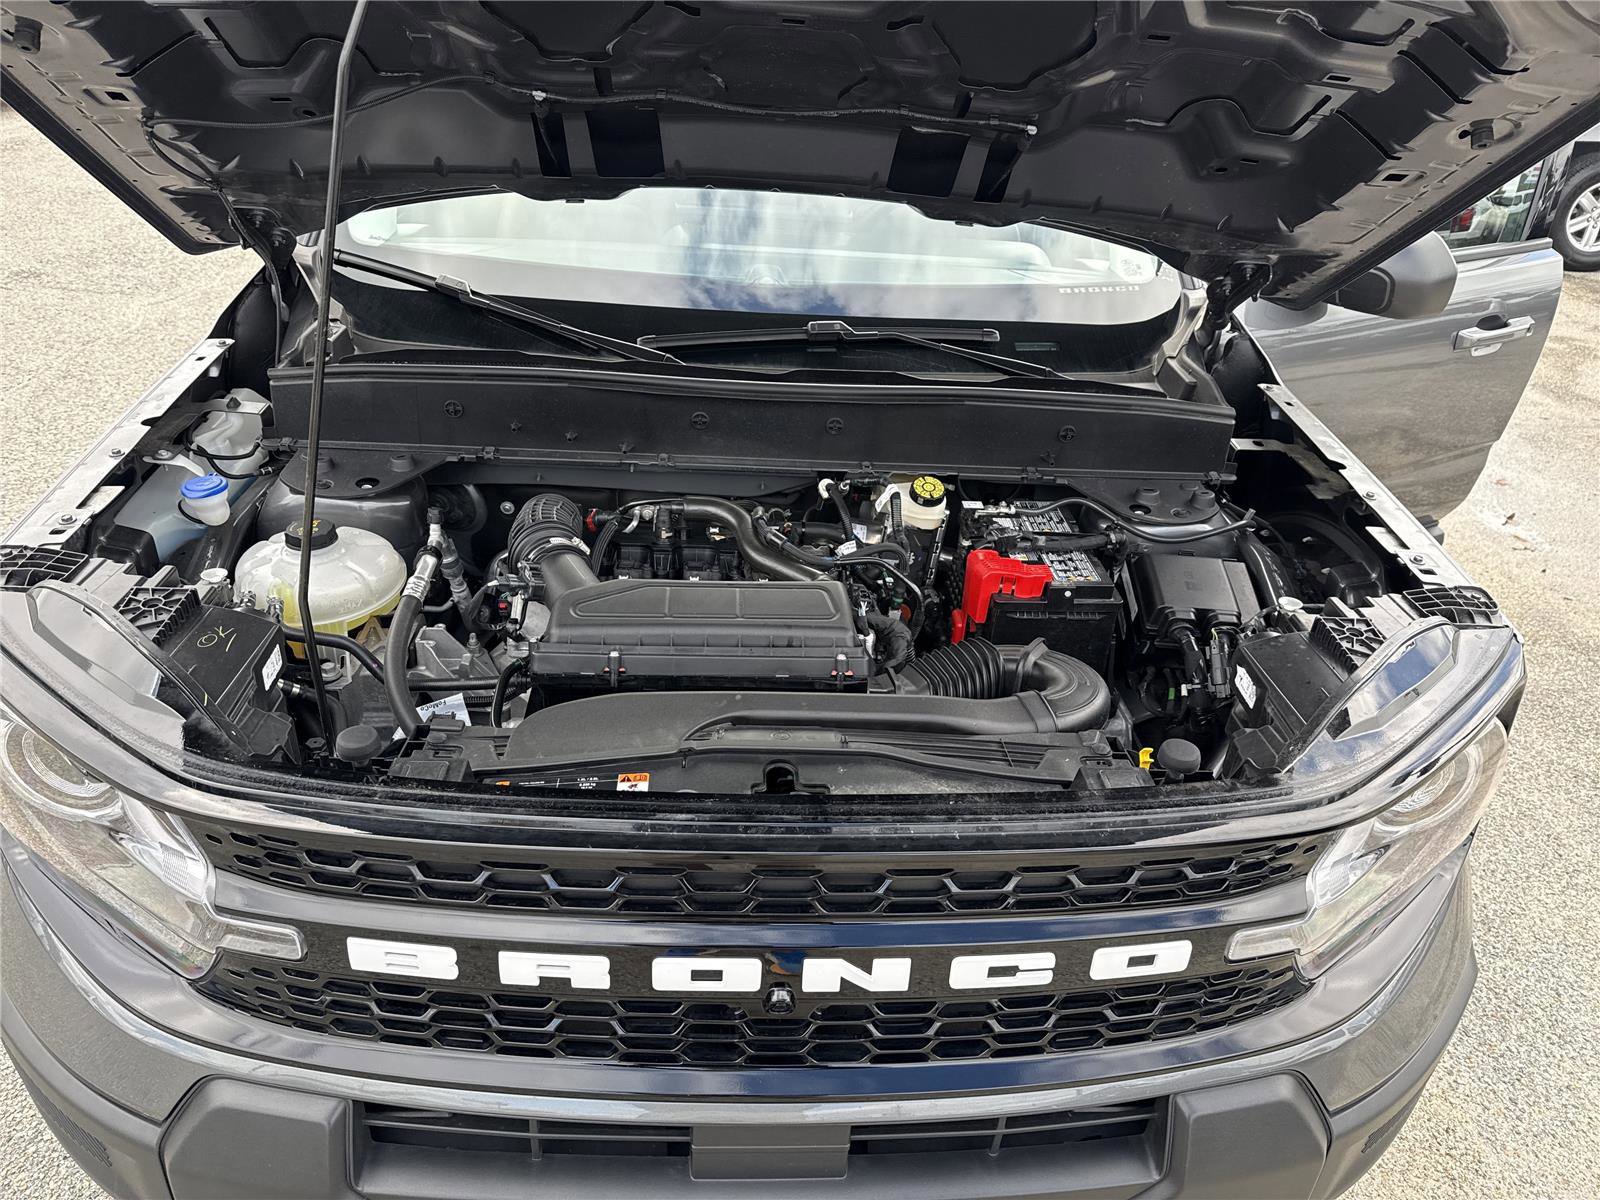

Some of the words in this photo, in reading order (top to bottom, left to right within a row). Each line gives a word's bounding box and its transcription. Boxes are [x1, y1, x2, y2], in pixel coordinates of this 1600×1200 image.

[197, 626, 237, 652] OK
[420, 699, 447, 712] FoMoCo
[347, 937, 1193, 993] BRONCO
